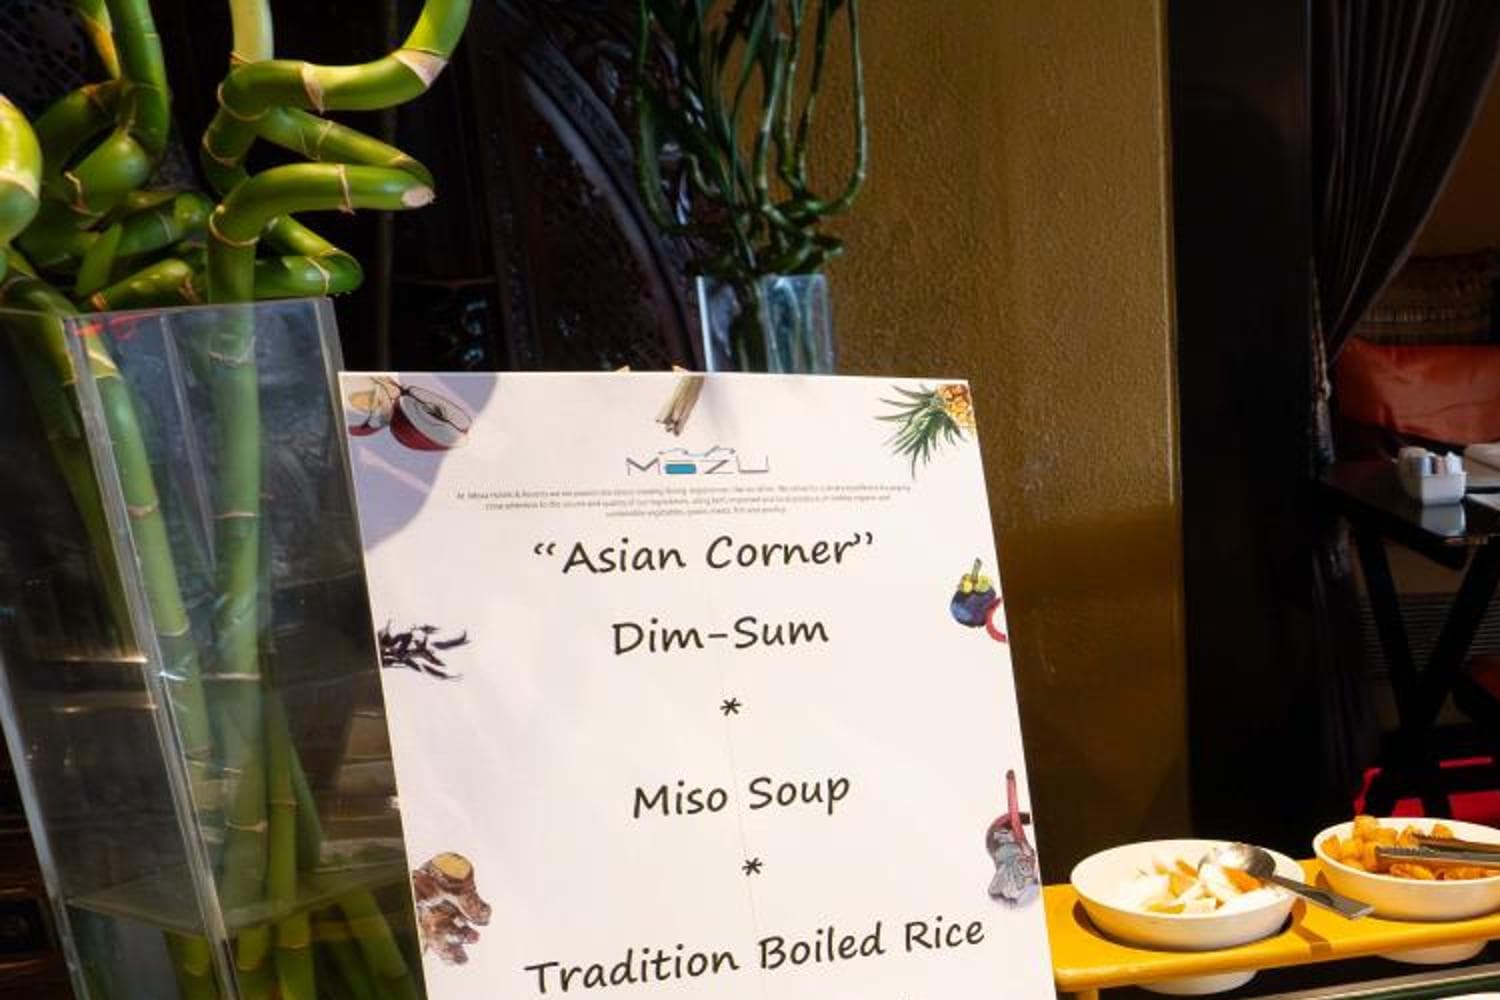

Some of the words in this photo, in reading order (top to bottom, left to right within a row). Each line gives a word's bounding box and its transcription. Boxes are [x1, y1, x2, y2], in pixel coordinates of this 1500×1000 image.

[612, 615, 829, 656] Dim-Sum
[633, 780, 728, 819] Miso
[749, 777, 850, 816] Soup
[524, 943, 740, 995] Tradition
[759, 921, 886, 971] Boiled
[904, 915, 985, 954] Rice
